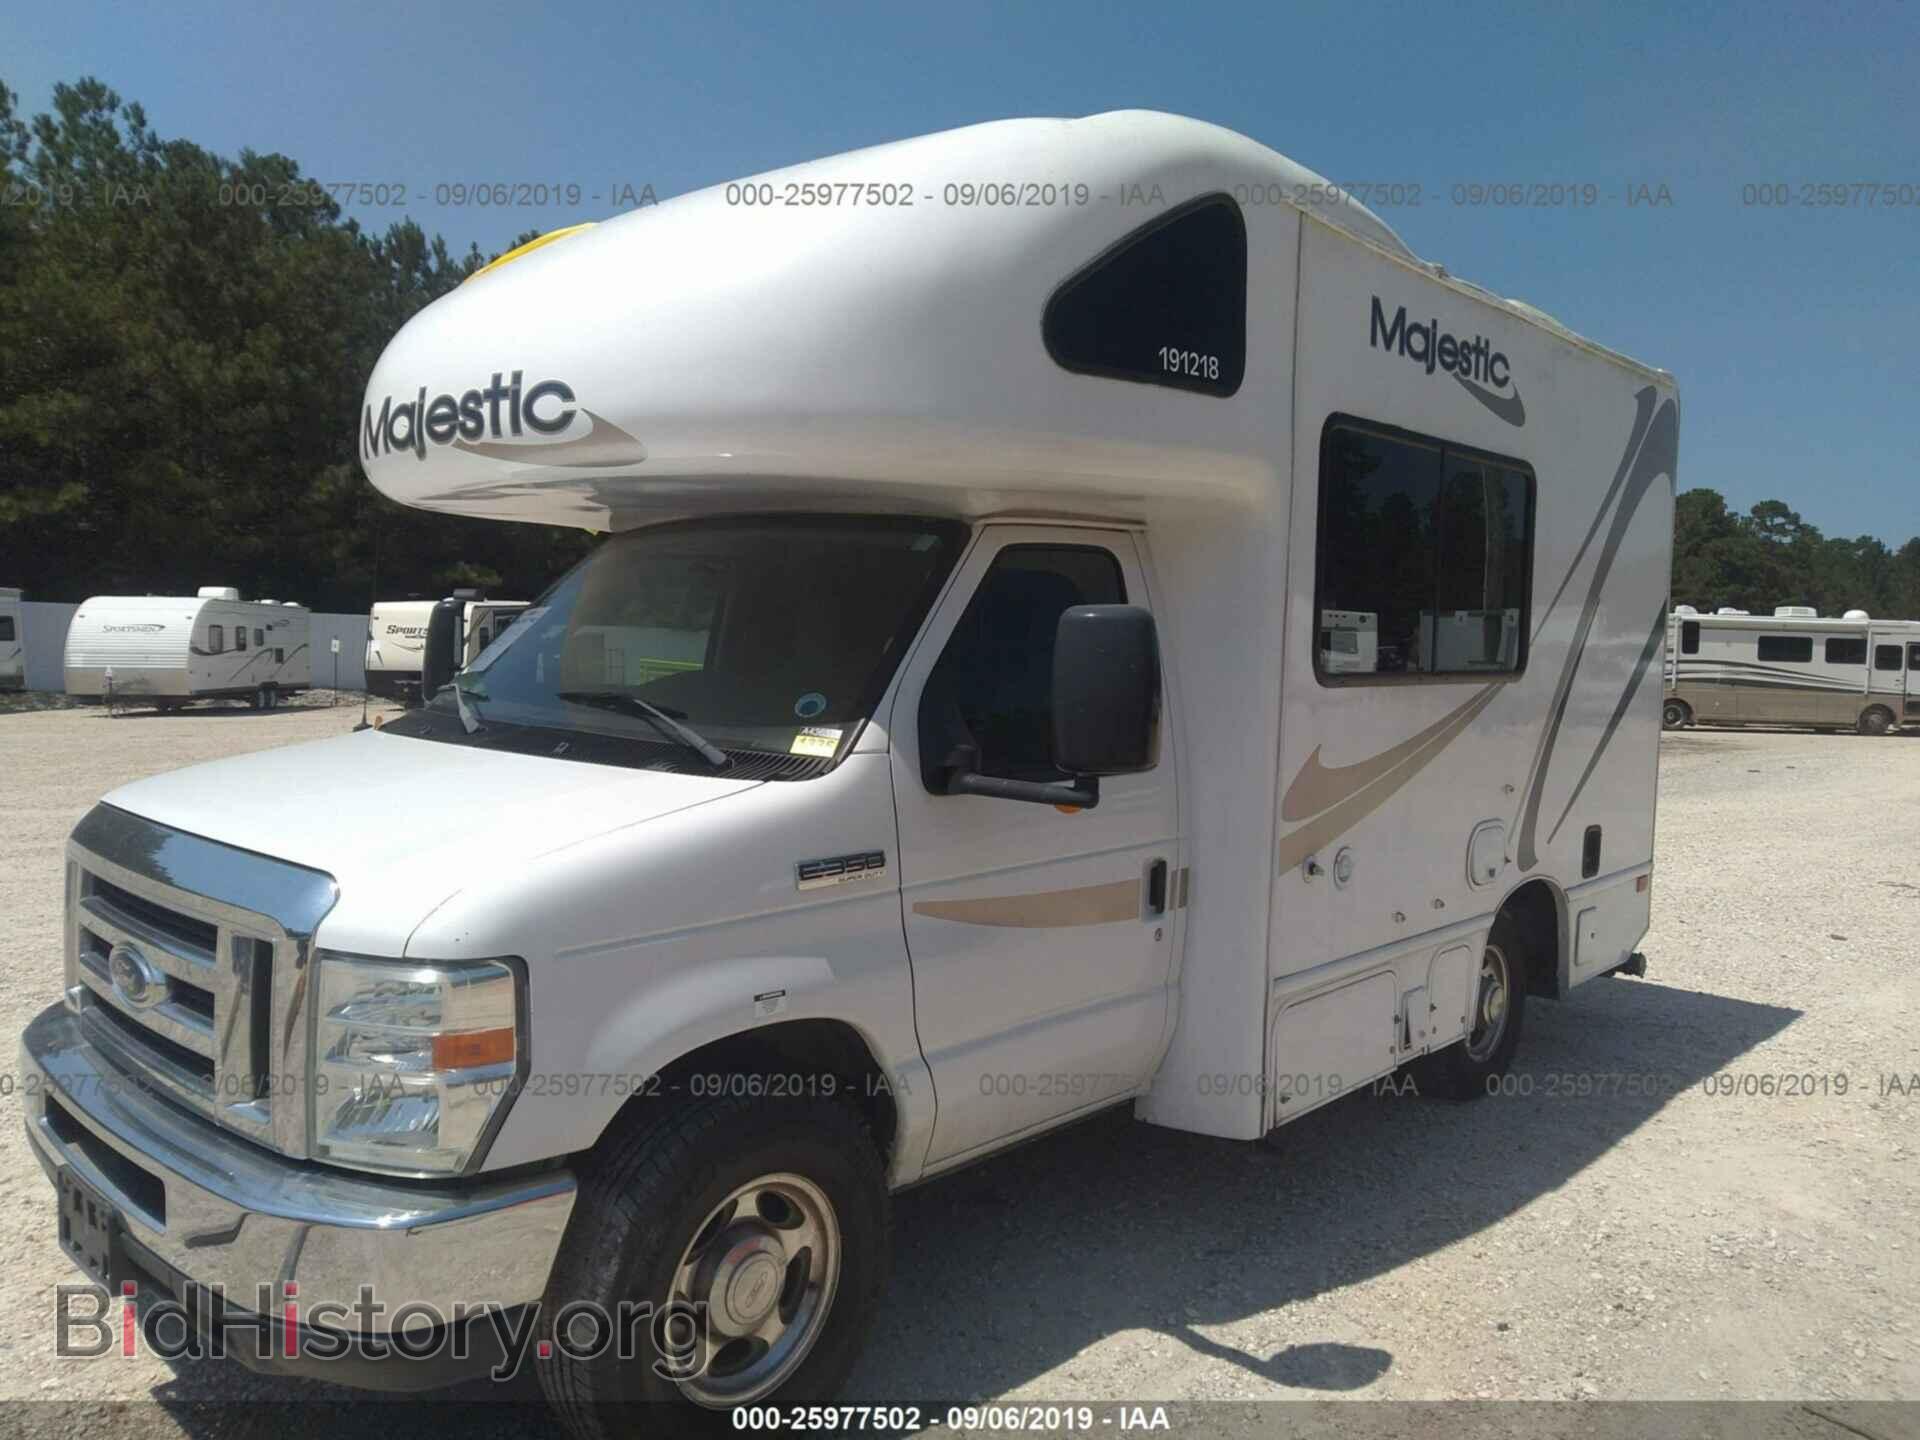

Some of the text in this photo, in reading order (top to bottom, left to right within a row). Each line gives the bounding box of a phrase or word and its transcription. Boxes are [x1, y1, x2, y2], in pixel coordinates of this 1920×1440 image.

[1159, 346, 1219, 380] 191218
[1370, 295, 1511, 388] Majestic
[363, 370, 577, 461] Majestic
